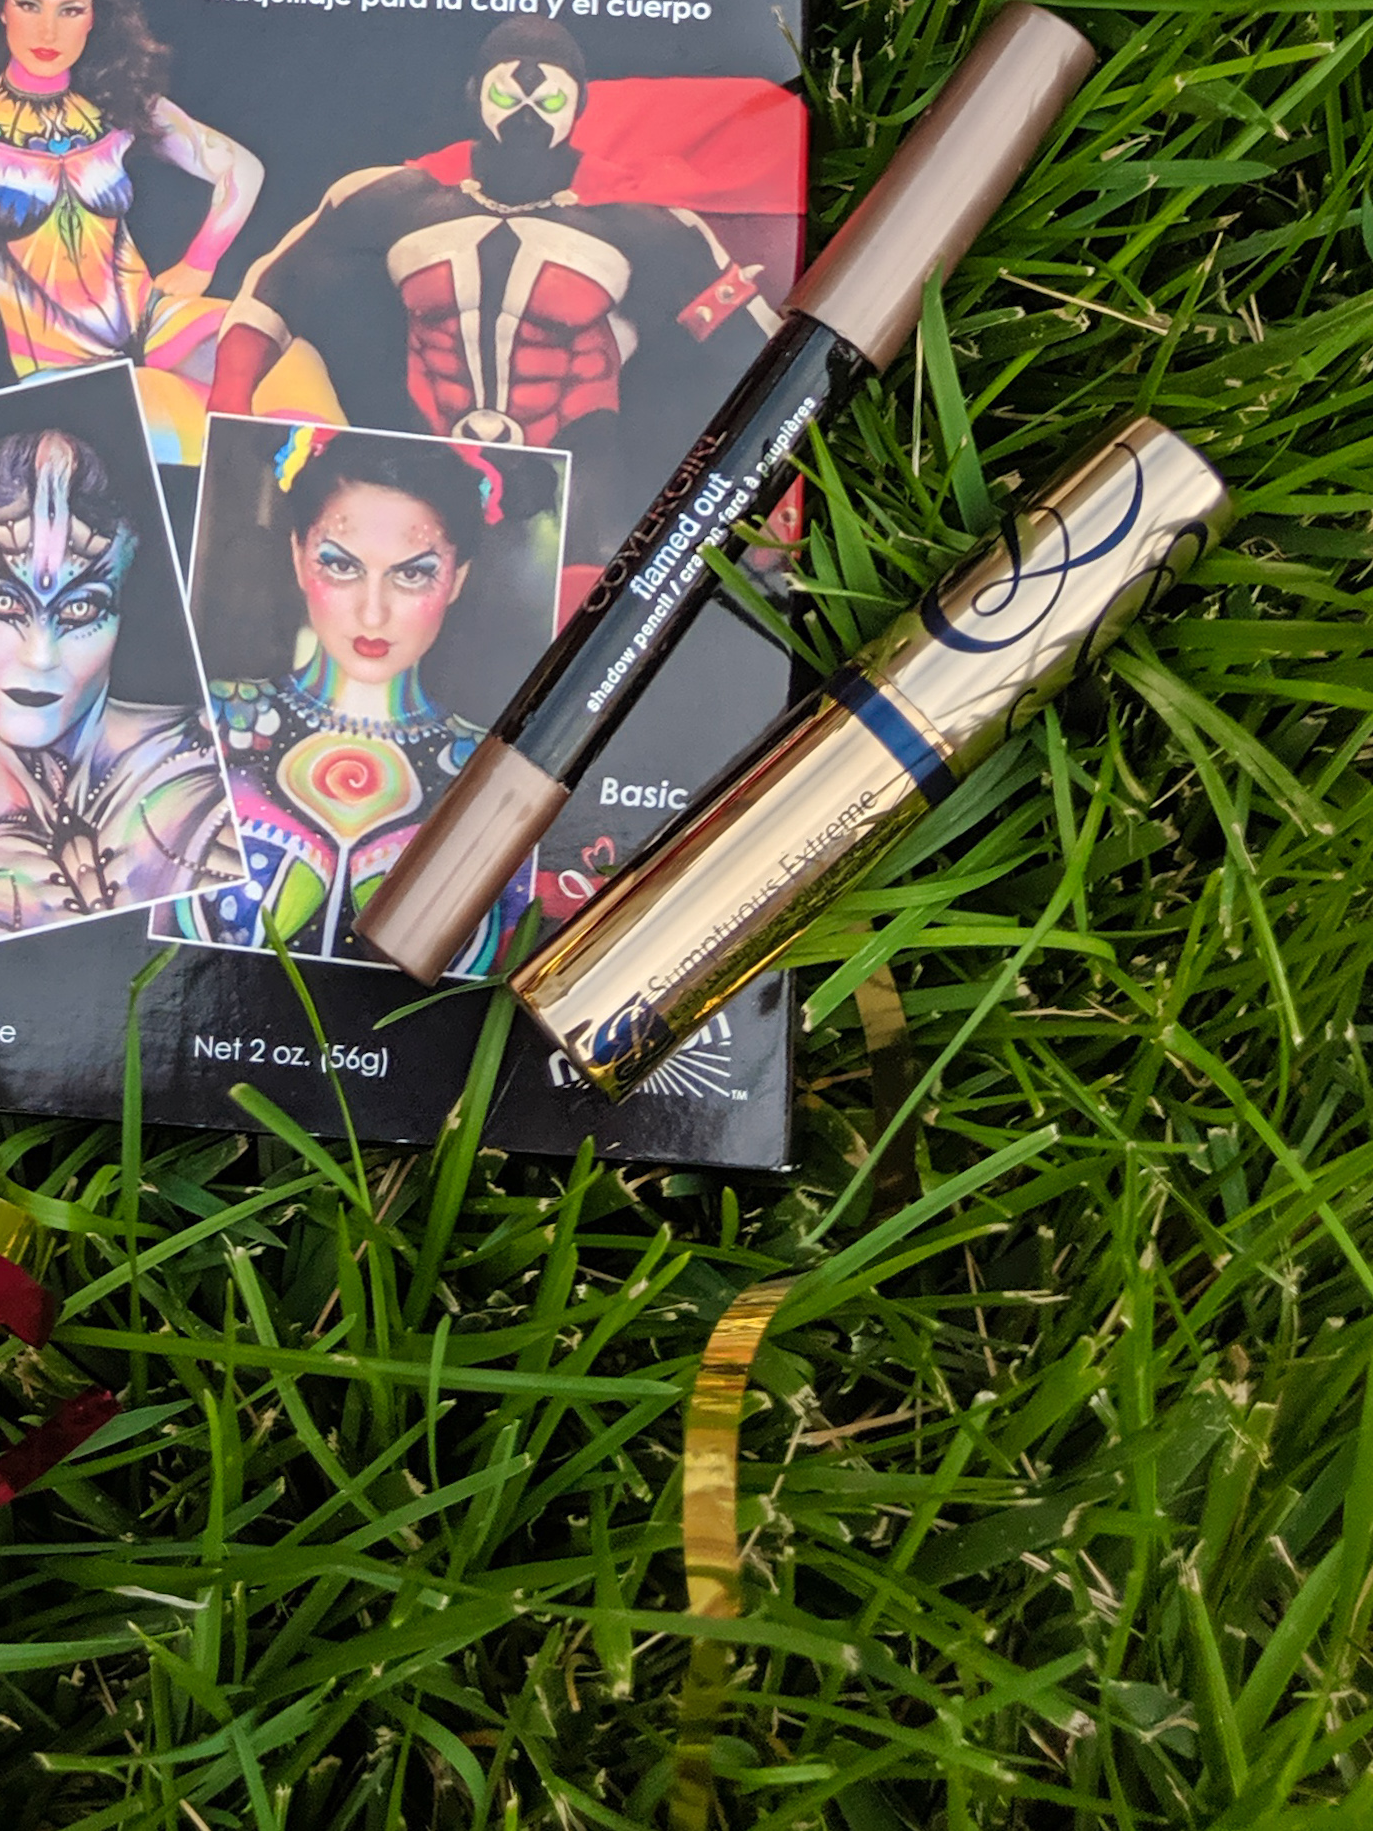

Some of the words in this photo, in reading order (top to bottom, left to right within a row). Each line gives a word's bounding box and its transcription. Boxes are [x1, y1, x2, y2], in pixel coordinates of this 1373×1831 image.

[583, 430, 728, 613] COVERGIRL
[586, 645, 637, 715] shadow
[632, 593, 675, 652] pencil
[680, 525, 725, 585] craon
[756, 395, 817, 479] paupières
[629, 512, 702, 602] flamed
[692, 470, 735, 518] out
[599, 776, 689, 810] Basic
[648, 878, 780, 994] Sumptuous
[777, 787, 878, 881] Extreme
[193, 1034, 243, 1061] Net
[248, 1037, 266, 1063] 2
[272, 1044, 312, 1067] oz.
[320, 1042, 389, 1078] (56g)
